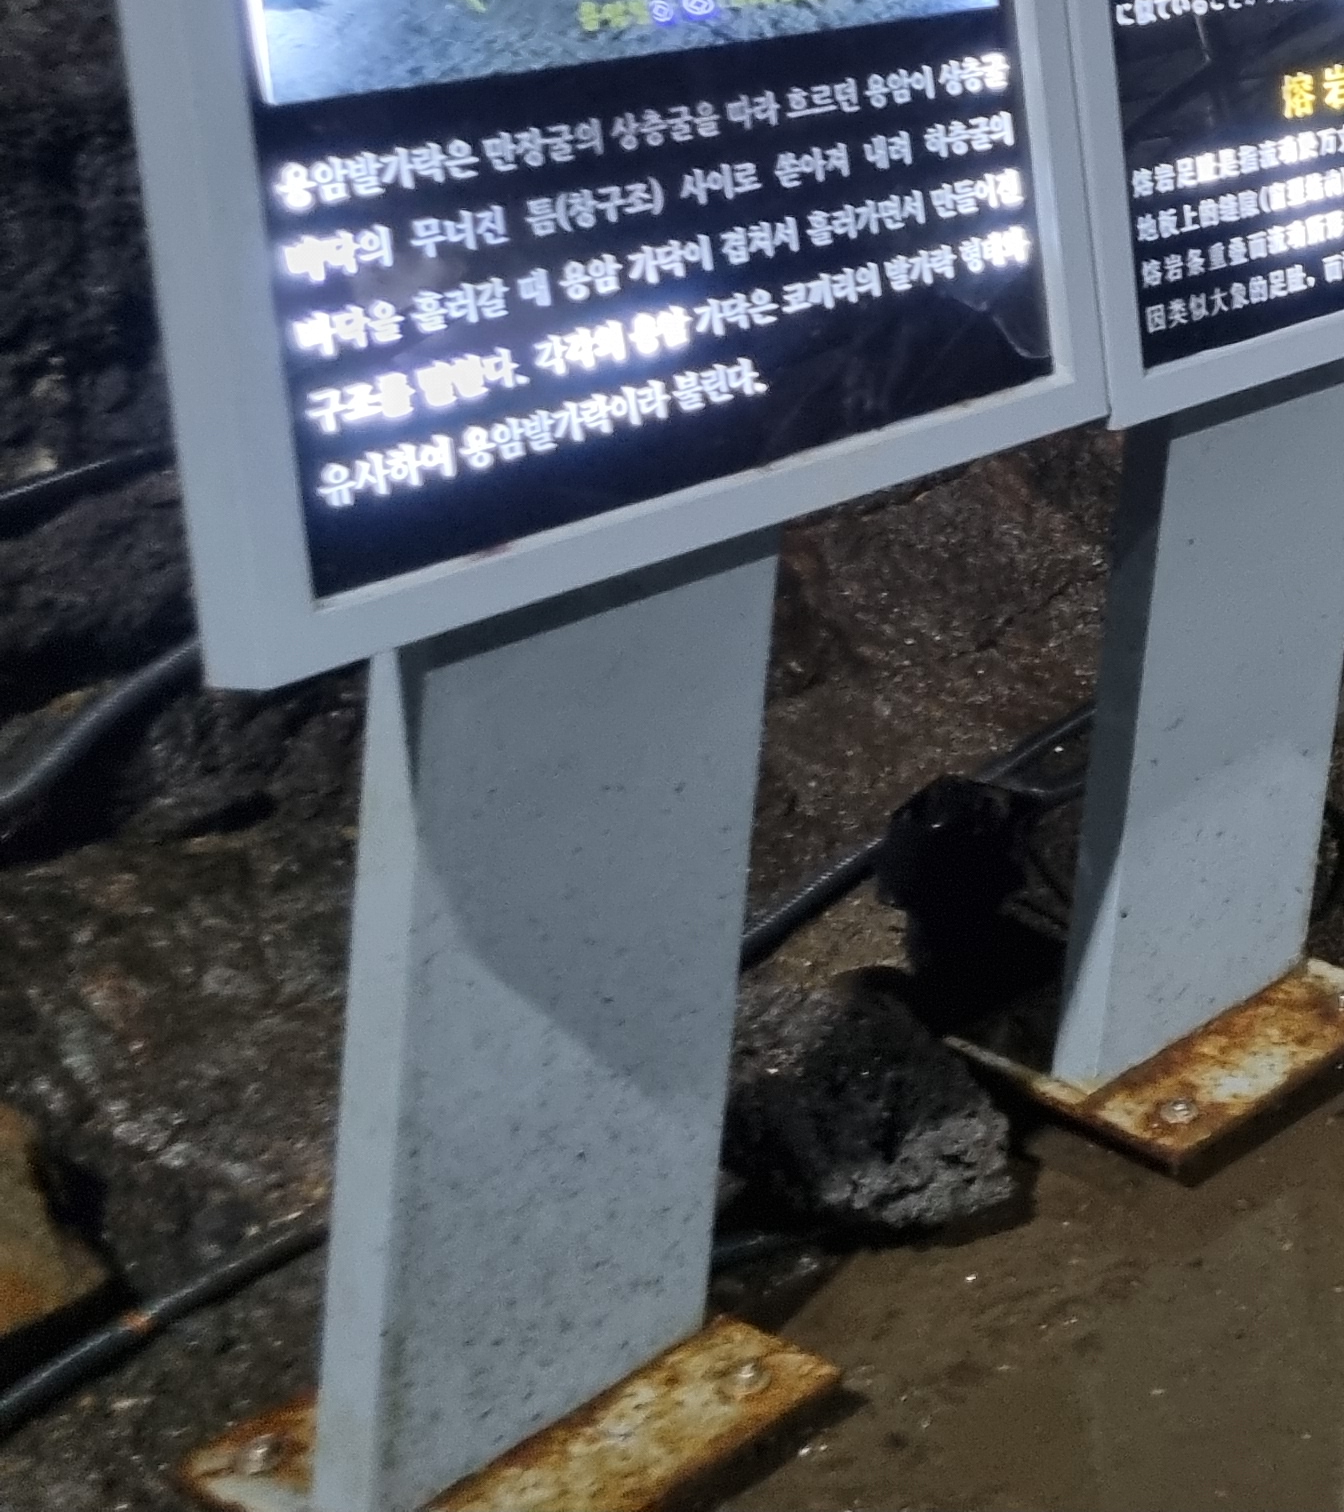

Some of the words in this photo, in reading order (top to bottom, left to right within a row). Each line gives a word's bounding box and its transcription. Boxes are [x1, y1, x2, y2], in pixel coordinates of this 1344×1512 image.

[276, 139, 478, 212] 용암발가락은
[482, 117, 604, 172] 만장굴의
[611, 101, 721, 150] 상층굴을
[725, 90, 781, 130] 따라
[786, 77, 860, 118] 흐르던
[864, 65, 935, 109] 용암이
[938, 52, 1010, 97] 상층굴
[411, 204, 510, 259] 무너진
[525, 176, 664, 238] 틈(창구조)
[680, 162, 763, 206] 사이로
[774, 142, 851, 188] 쏟아져
[863, 131, 914, 170] 내려
[923, 111, 1015, 158] 하층굴의
[411, 277, 510, 334] 흘러갈
[517, 268, 552, 306] 때
[559, 254, 623, 302] 용암
[627, 234, 715, 286] 가닥이
[720, 216, 800, 266] 겹쳐서
[806, 189, 927, 247] 흘러가면서
[929, 168, 1025, 220] 만들어진
[694, 289, 779, 336] 가닥은
[782, 262, 883, 314] 코끼리의
[884, 244, 957, 292] 발가락
[316, 434, 458, 507] 유사하여
[459, 379, 671, 469] 용암발가락이라
[672, 357, 770, 413] 불린다.
